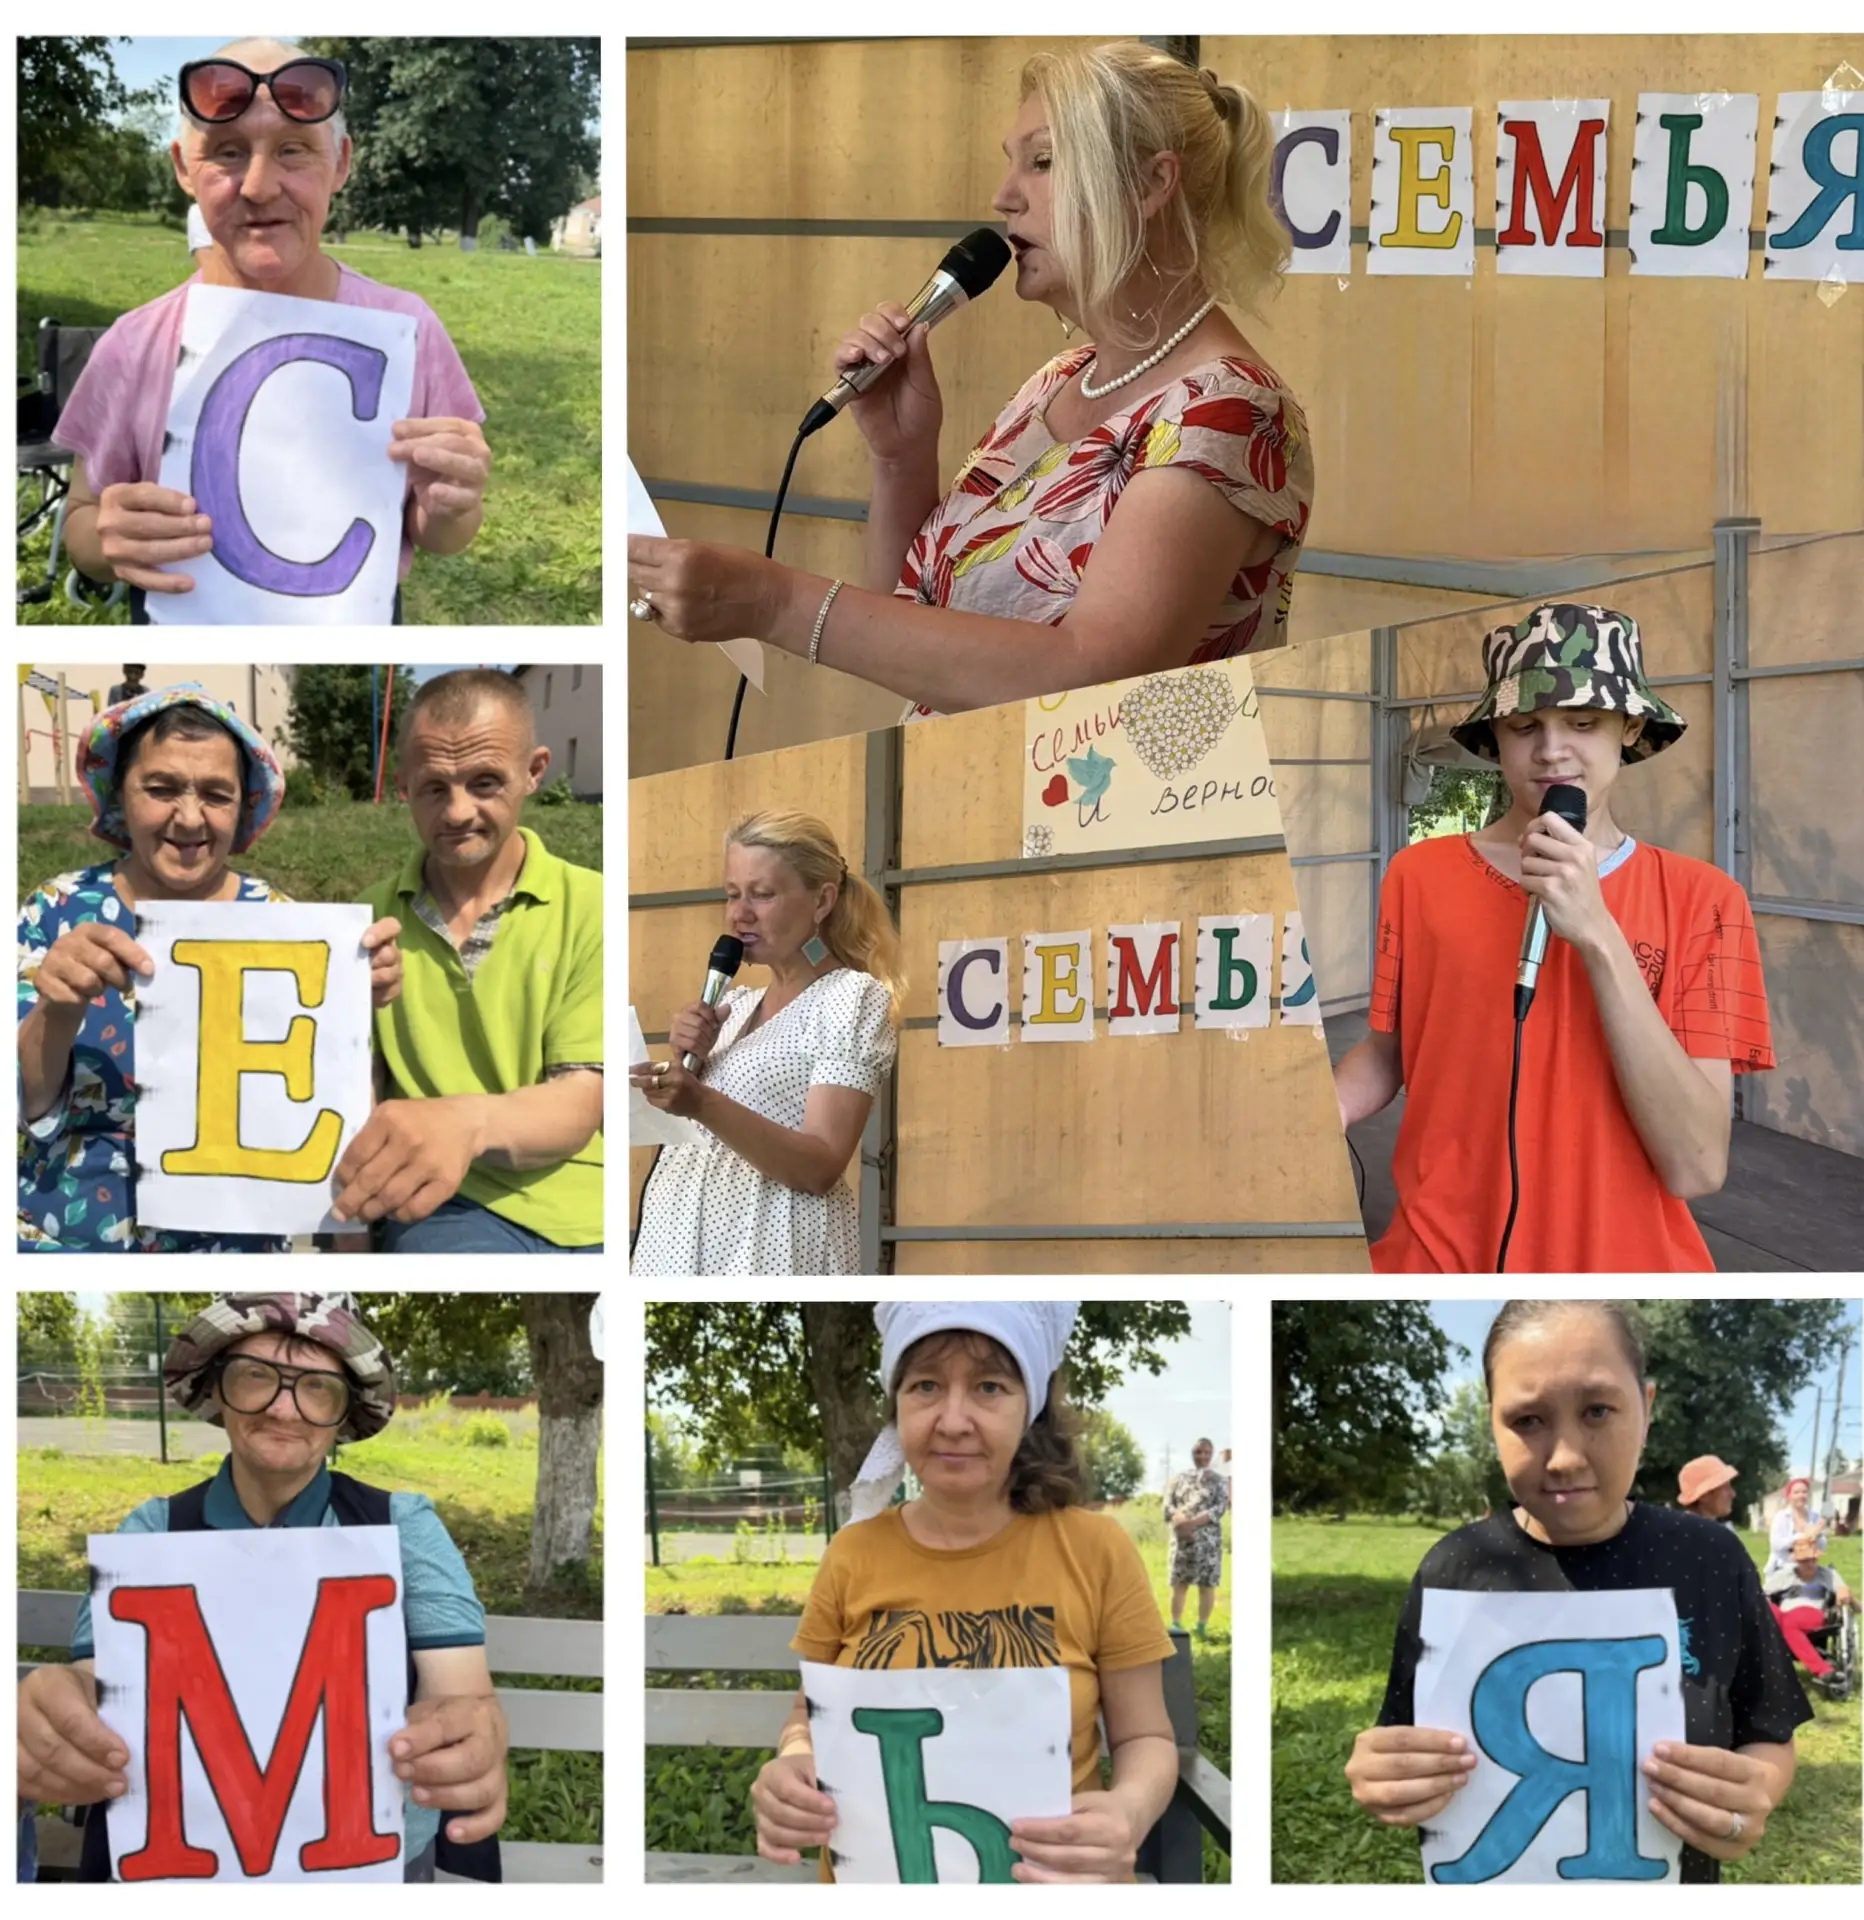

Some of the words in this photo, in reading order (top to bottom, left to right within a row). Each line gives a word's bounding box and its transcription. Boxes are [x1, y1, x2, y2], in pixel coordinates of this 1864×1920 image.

[190, 332, 388, 597] С
[160, 939, 345, 1183] Е
[109, 1574, 400, 1882] М
[1430, 1634, 1668, 1884] Я
